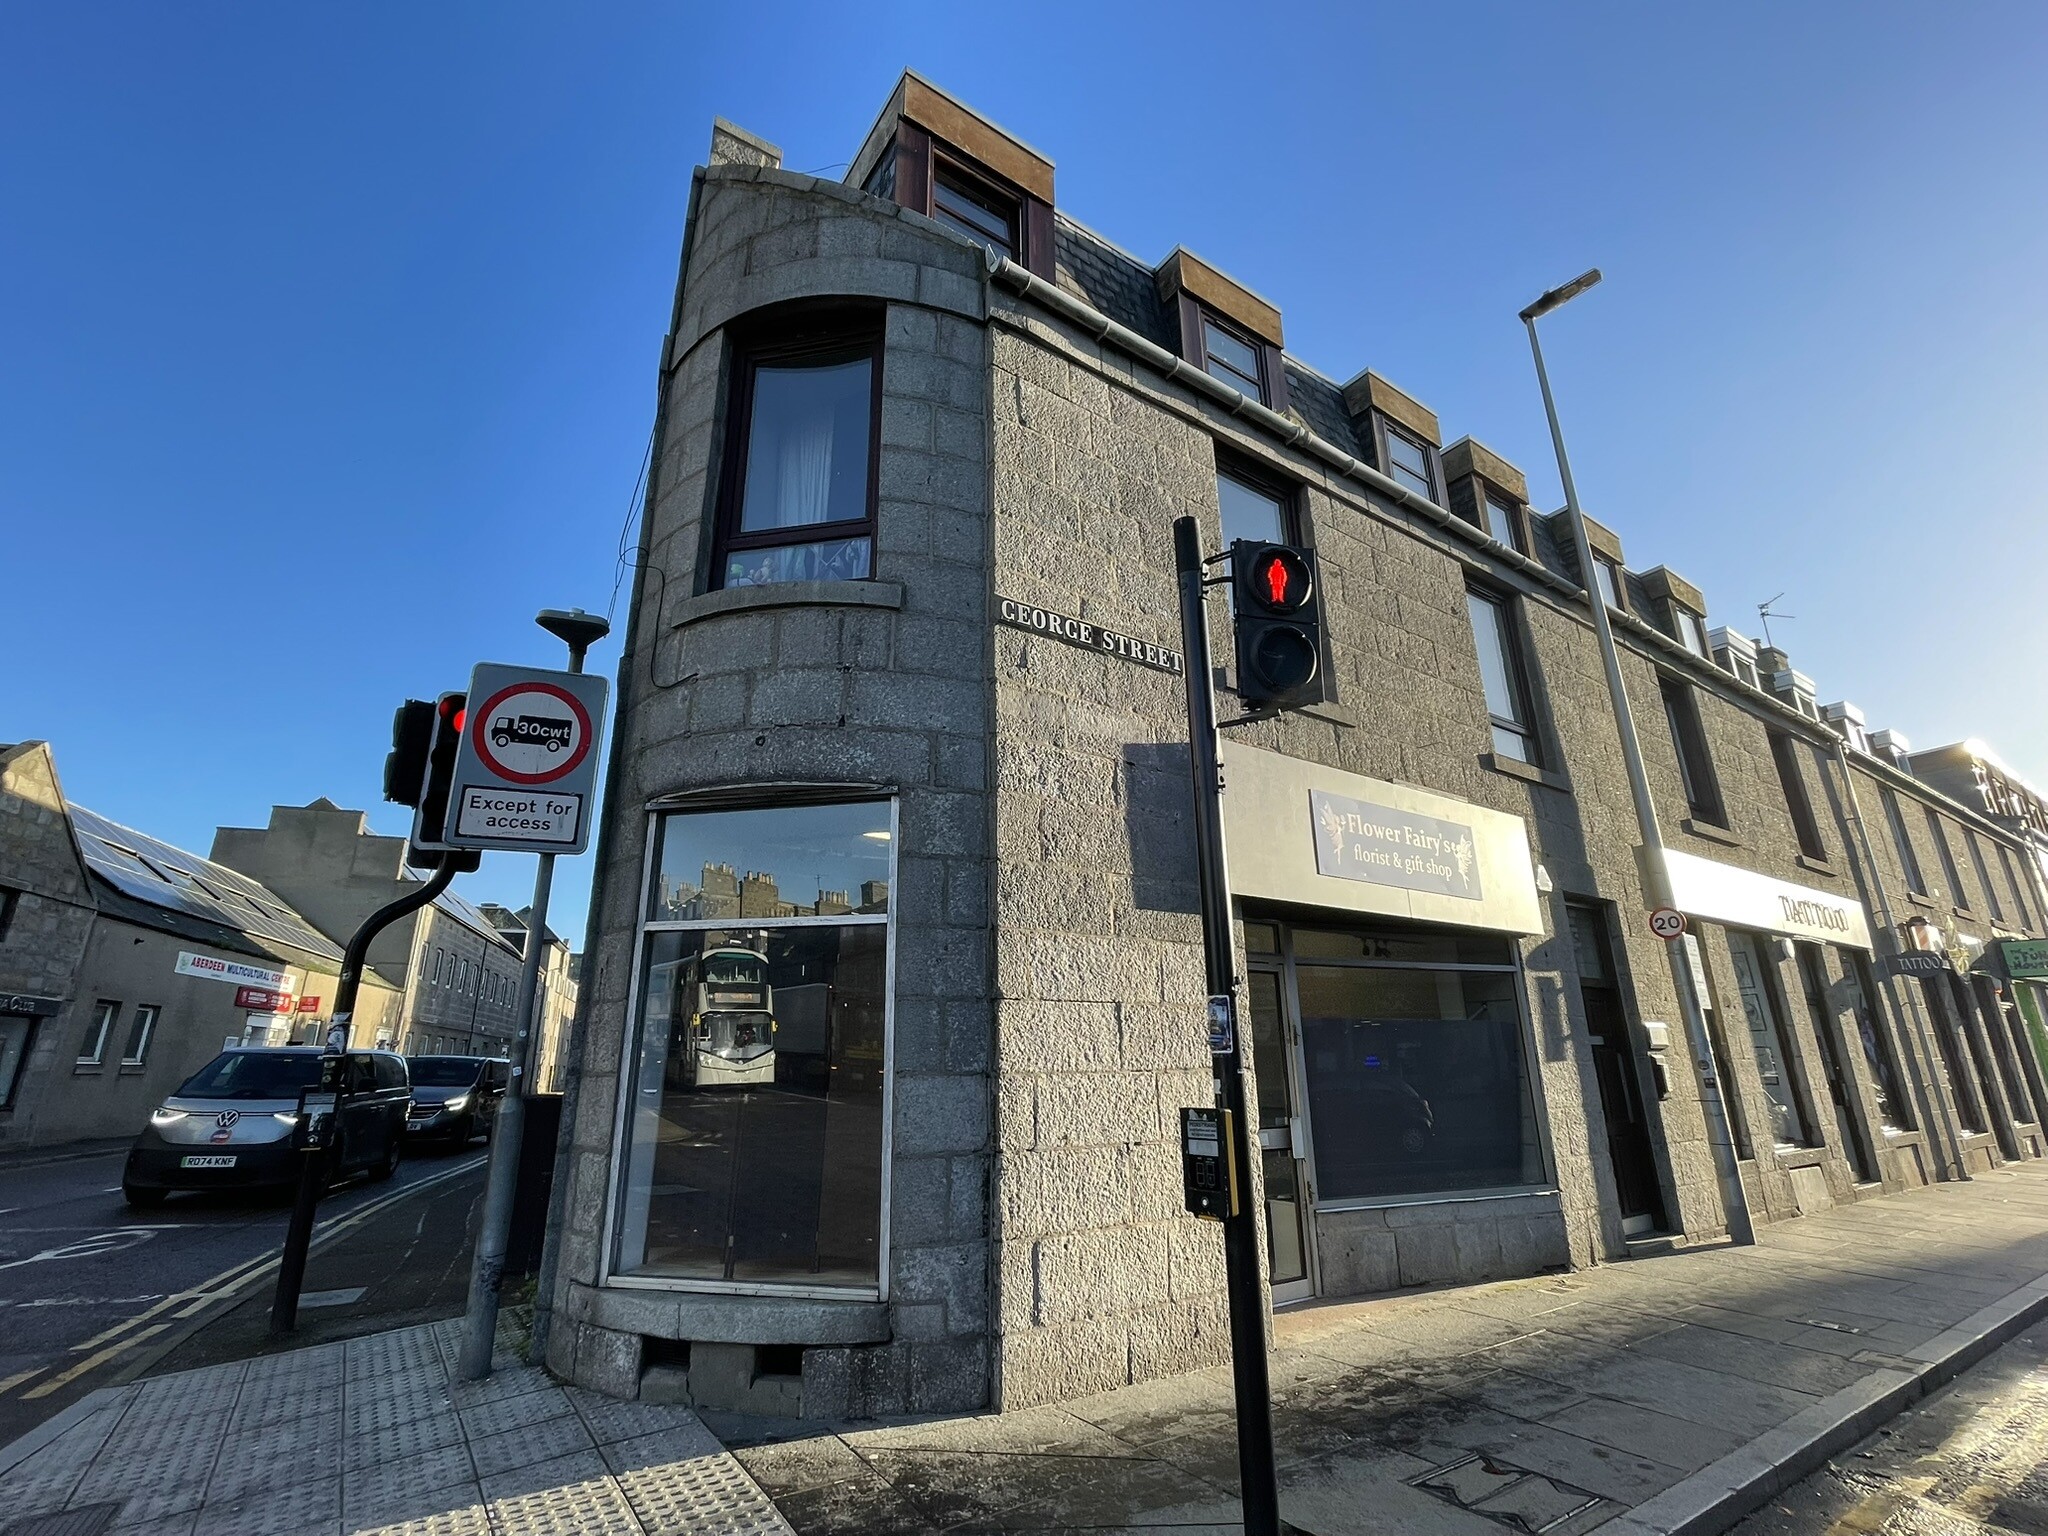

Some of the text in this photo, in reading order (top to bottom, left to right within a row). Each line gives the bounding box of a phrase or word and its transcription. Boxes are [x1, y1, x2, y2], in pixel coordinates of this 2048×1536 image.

[1001, 599, 1183, 672] GEORGE STREET
[517, 721, 571, 740] 30cwt
[469, 795, 573, 816] Except for
[485, 815, 551, 831] access
[1347, 813, 1451, 857] Flower Fairy's
[1353, 843, 1453, 882] florist & gift shop
[1654, 915, 1680, 931] 20
[190, 957, 290, 985] ABERDEEN MULTICULTURAL CENTRE
[1897, 956, 1941, 971] TATTOO
